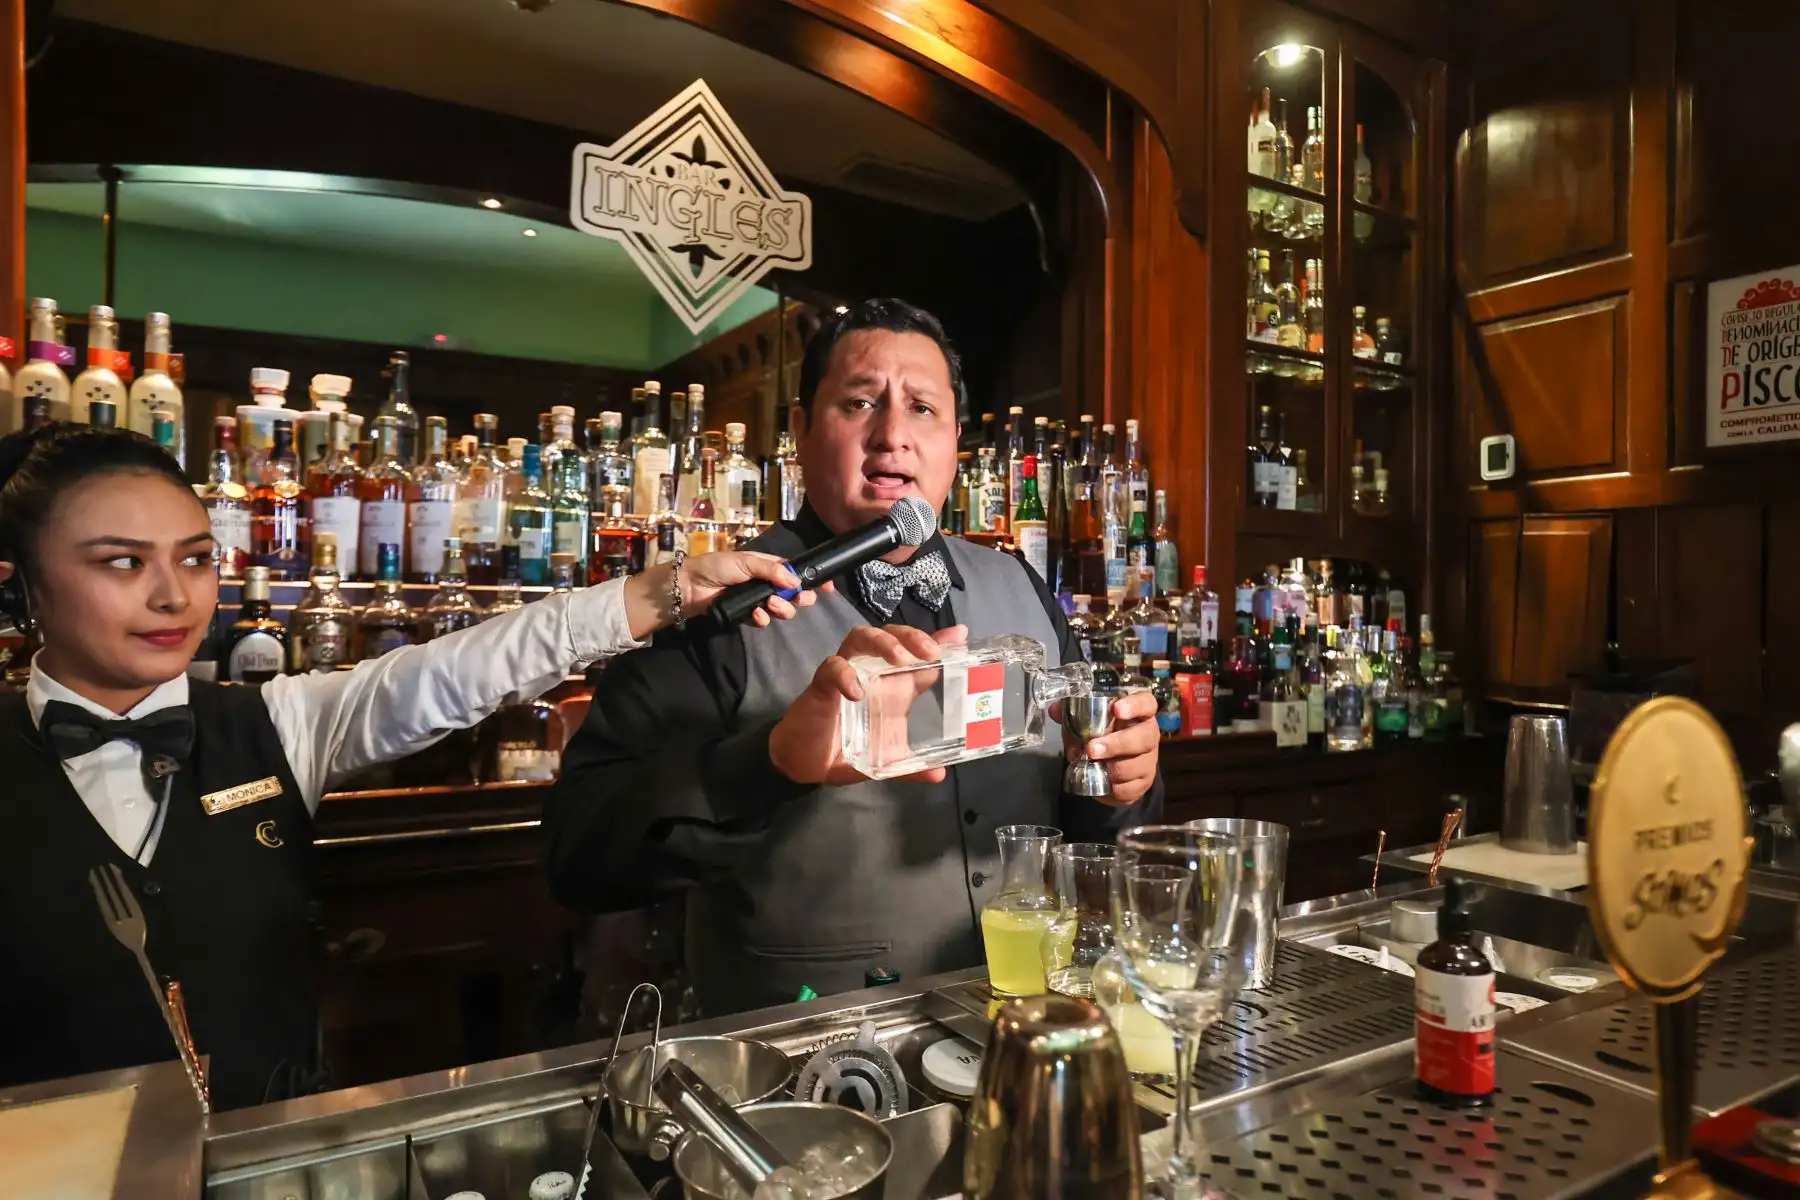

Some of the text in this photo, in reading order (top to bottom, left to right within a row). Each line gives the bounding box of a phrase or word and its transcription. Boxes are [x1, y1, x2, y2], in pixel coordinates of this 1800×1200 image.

[676, 162, 718, 186] BAR
[1720, 345, 1741, 368] DE
[226, 783, 272, 802] MONICA
